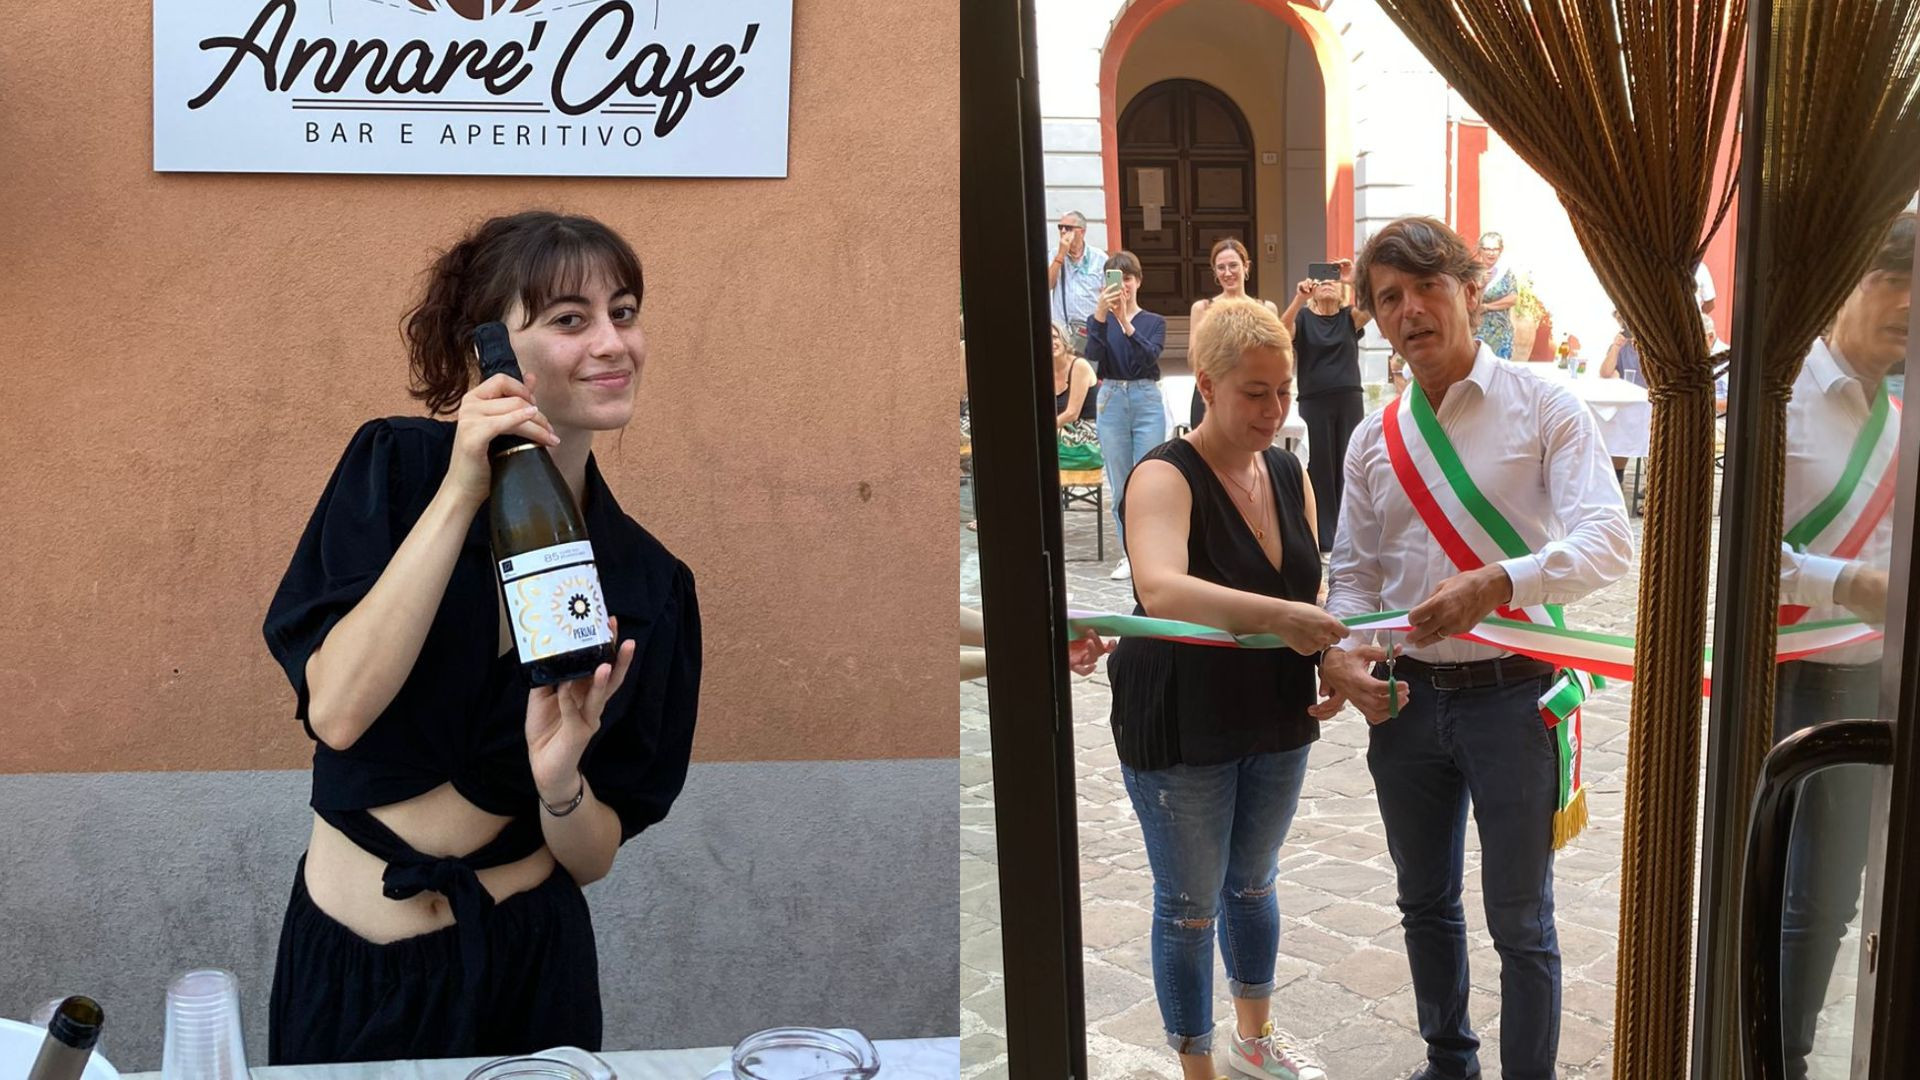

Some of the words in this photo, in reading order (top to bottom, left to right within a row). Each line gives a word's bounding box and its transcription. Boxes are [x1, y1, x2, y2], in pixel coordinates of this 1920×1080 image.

[305, 122, 373, 143] BAR
[401, 123, 413, 144] E
[440, 124, 642, 147] APERITIVO
